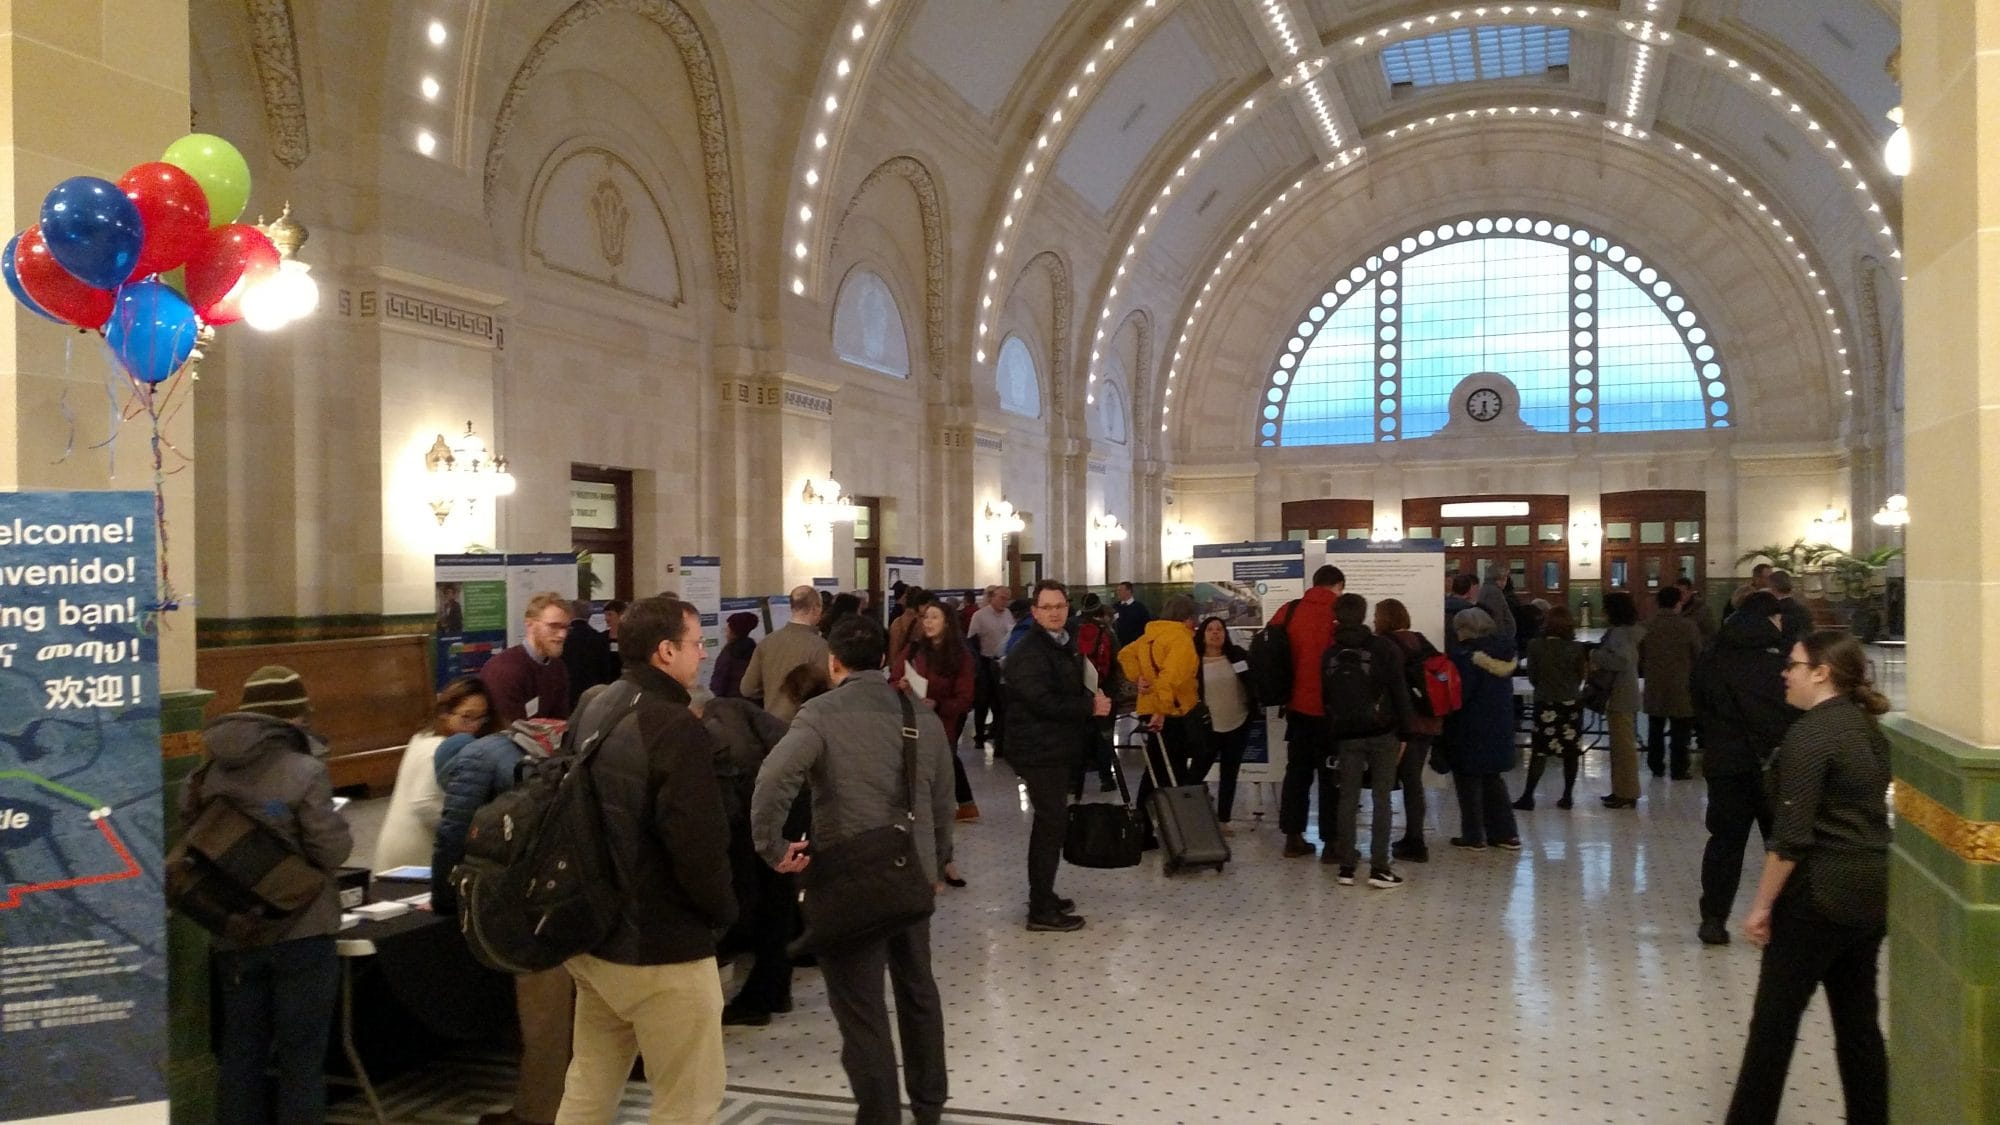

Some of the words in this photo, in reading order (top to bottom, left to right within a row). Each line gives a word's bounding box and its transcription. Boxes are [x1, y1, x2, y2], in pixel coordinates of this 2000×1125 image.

[0, 516, 134, 546] elcome!
[0, 556, 136, 586] venido!
[0, 604, 46, 632] ng
[58, 597, 136, 632] bạn!
